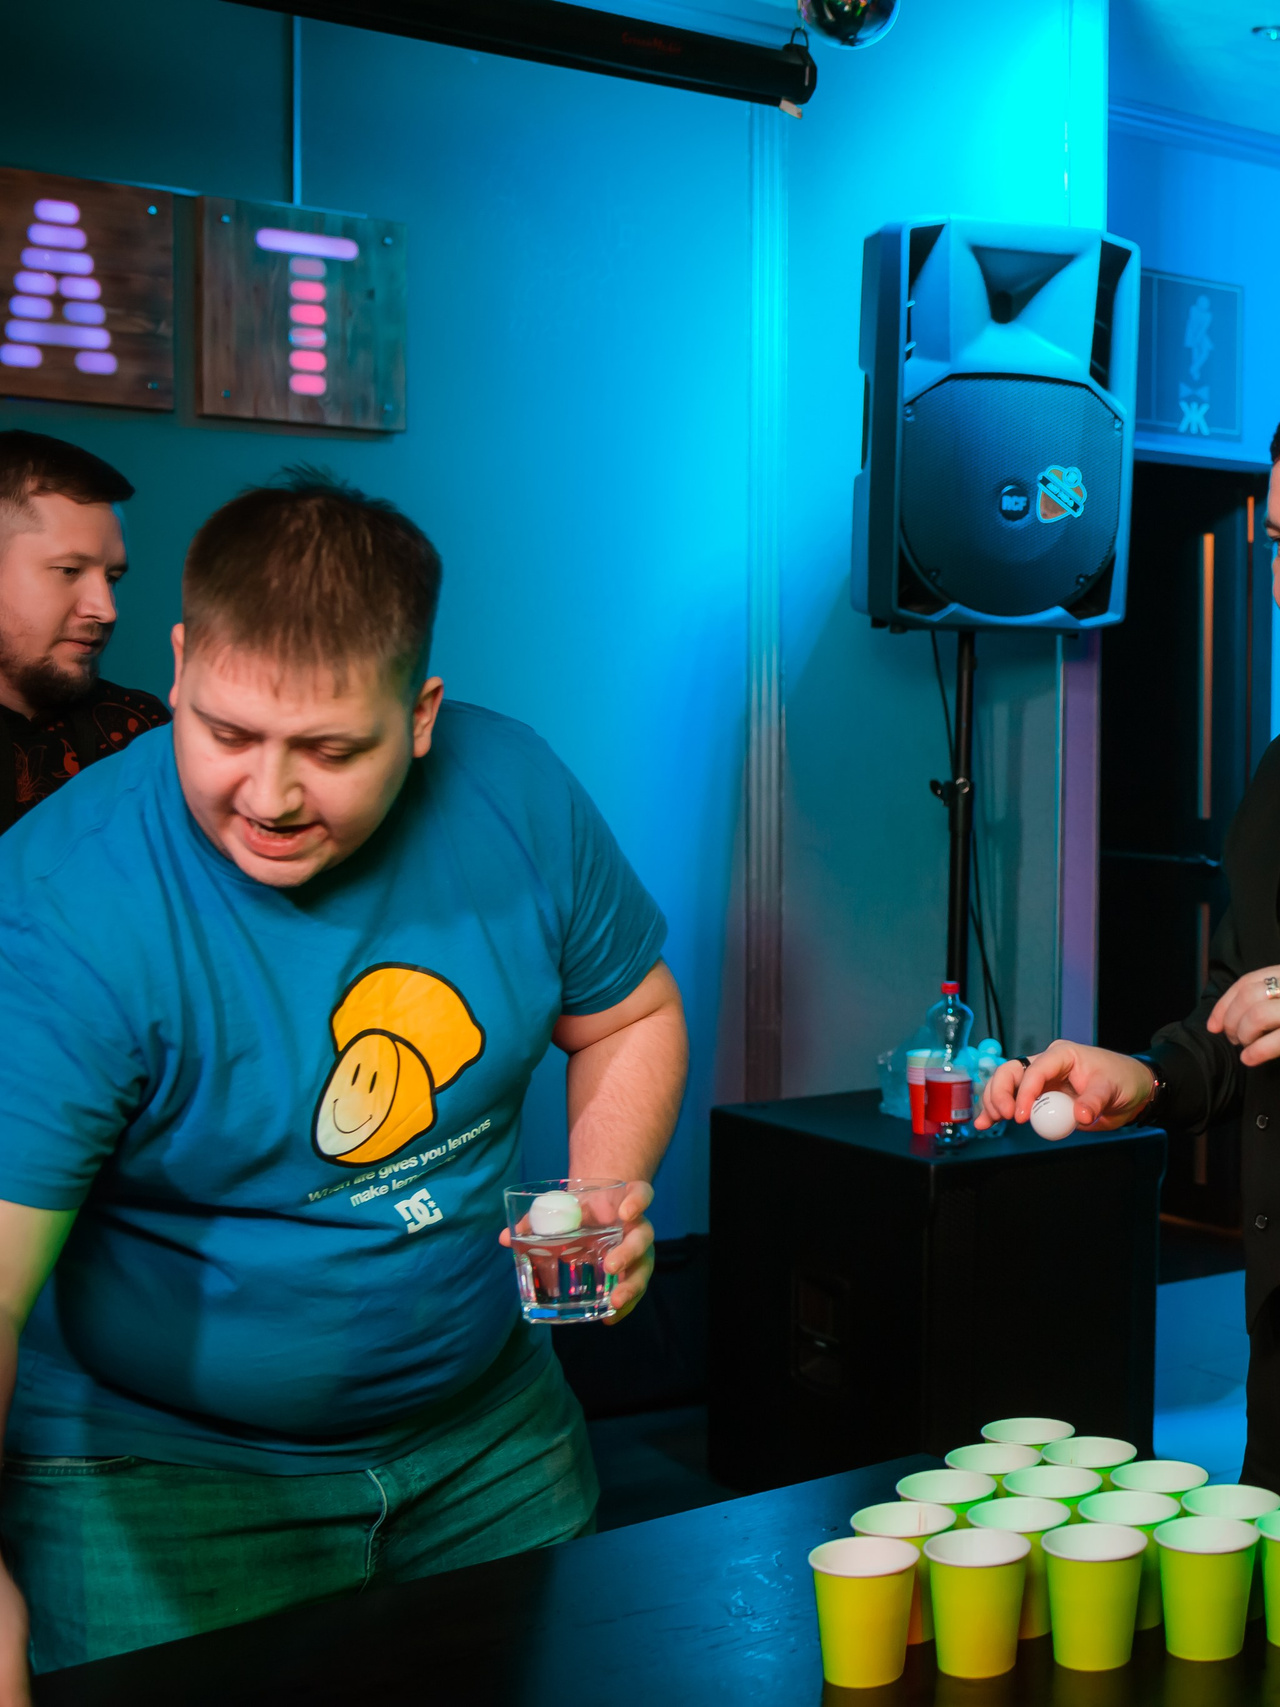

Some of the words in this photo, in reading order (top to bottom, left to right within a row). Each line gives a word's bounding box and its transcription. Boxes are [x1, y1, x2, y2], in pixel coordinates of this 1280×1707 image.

[1178, 401, 1210, 436] Ж
[378, 1155, 418, 1179] gives
[419, 1145, 447, 1166] you
[448, 1118, 491, 1151] lemons
[350, 1184, 389, 1207] make
